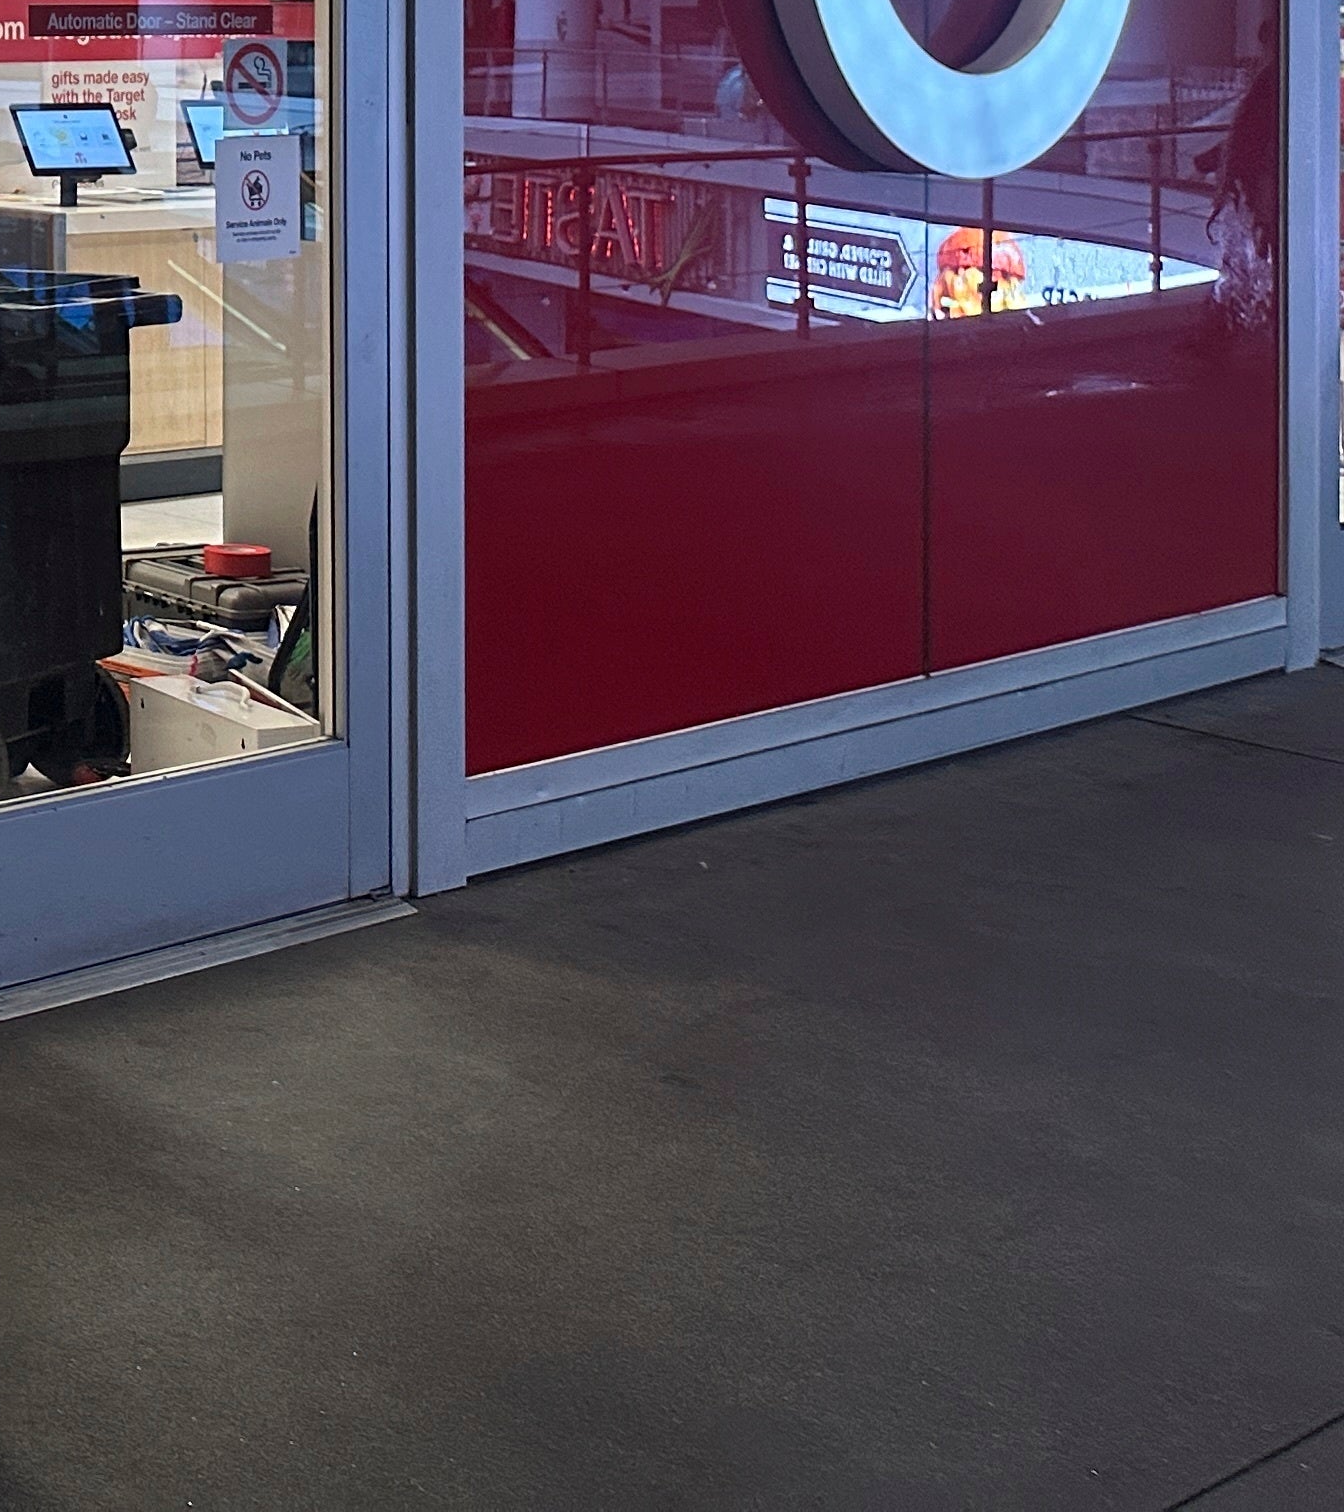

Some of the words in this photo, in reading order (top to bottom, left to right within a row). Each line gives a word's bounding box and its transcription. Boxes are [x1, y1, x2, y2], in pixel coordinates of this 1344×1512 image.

[47, 12, 123, 30] Automatic
[126, 12, 162, 30] Door
[176, 12, 217, 30] Stand
[220, 12, 257, 29] Clear
[51, 71, 80, 88] gifts
[83, 70, 119, 85] made
[122, 71, 150, 86] easy
[52, 88, 79, 104] with
[82, 88, 103, 104] the
[106, 88, 146, 105] Target
[240, 151, 252, 162] No
[253, 150, 272, 161] Pets
